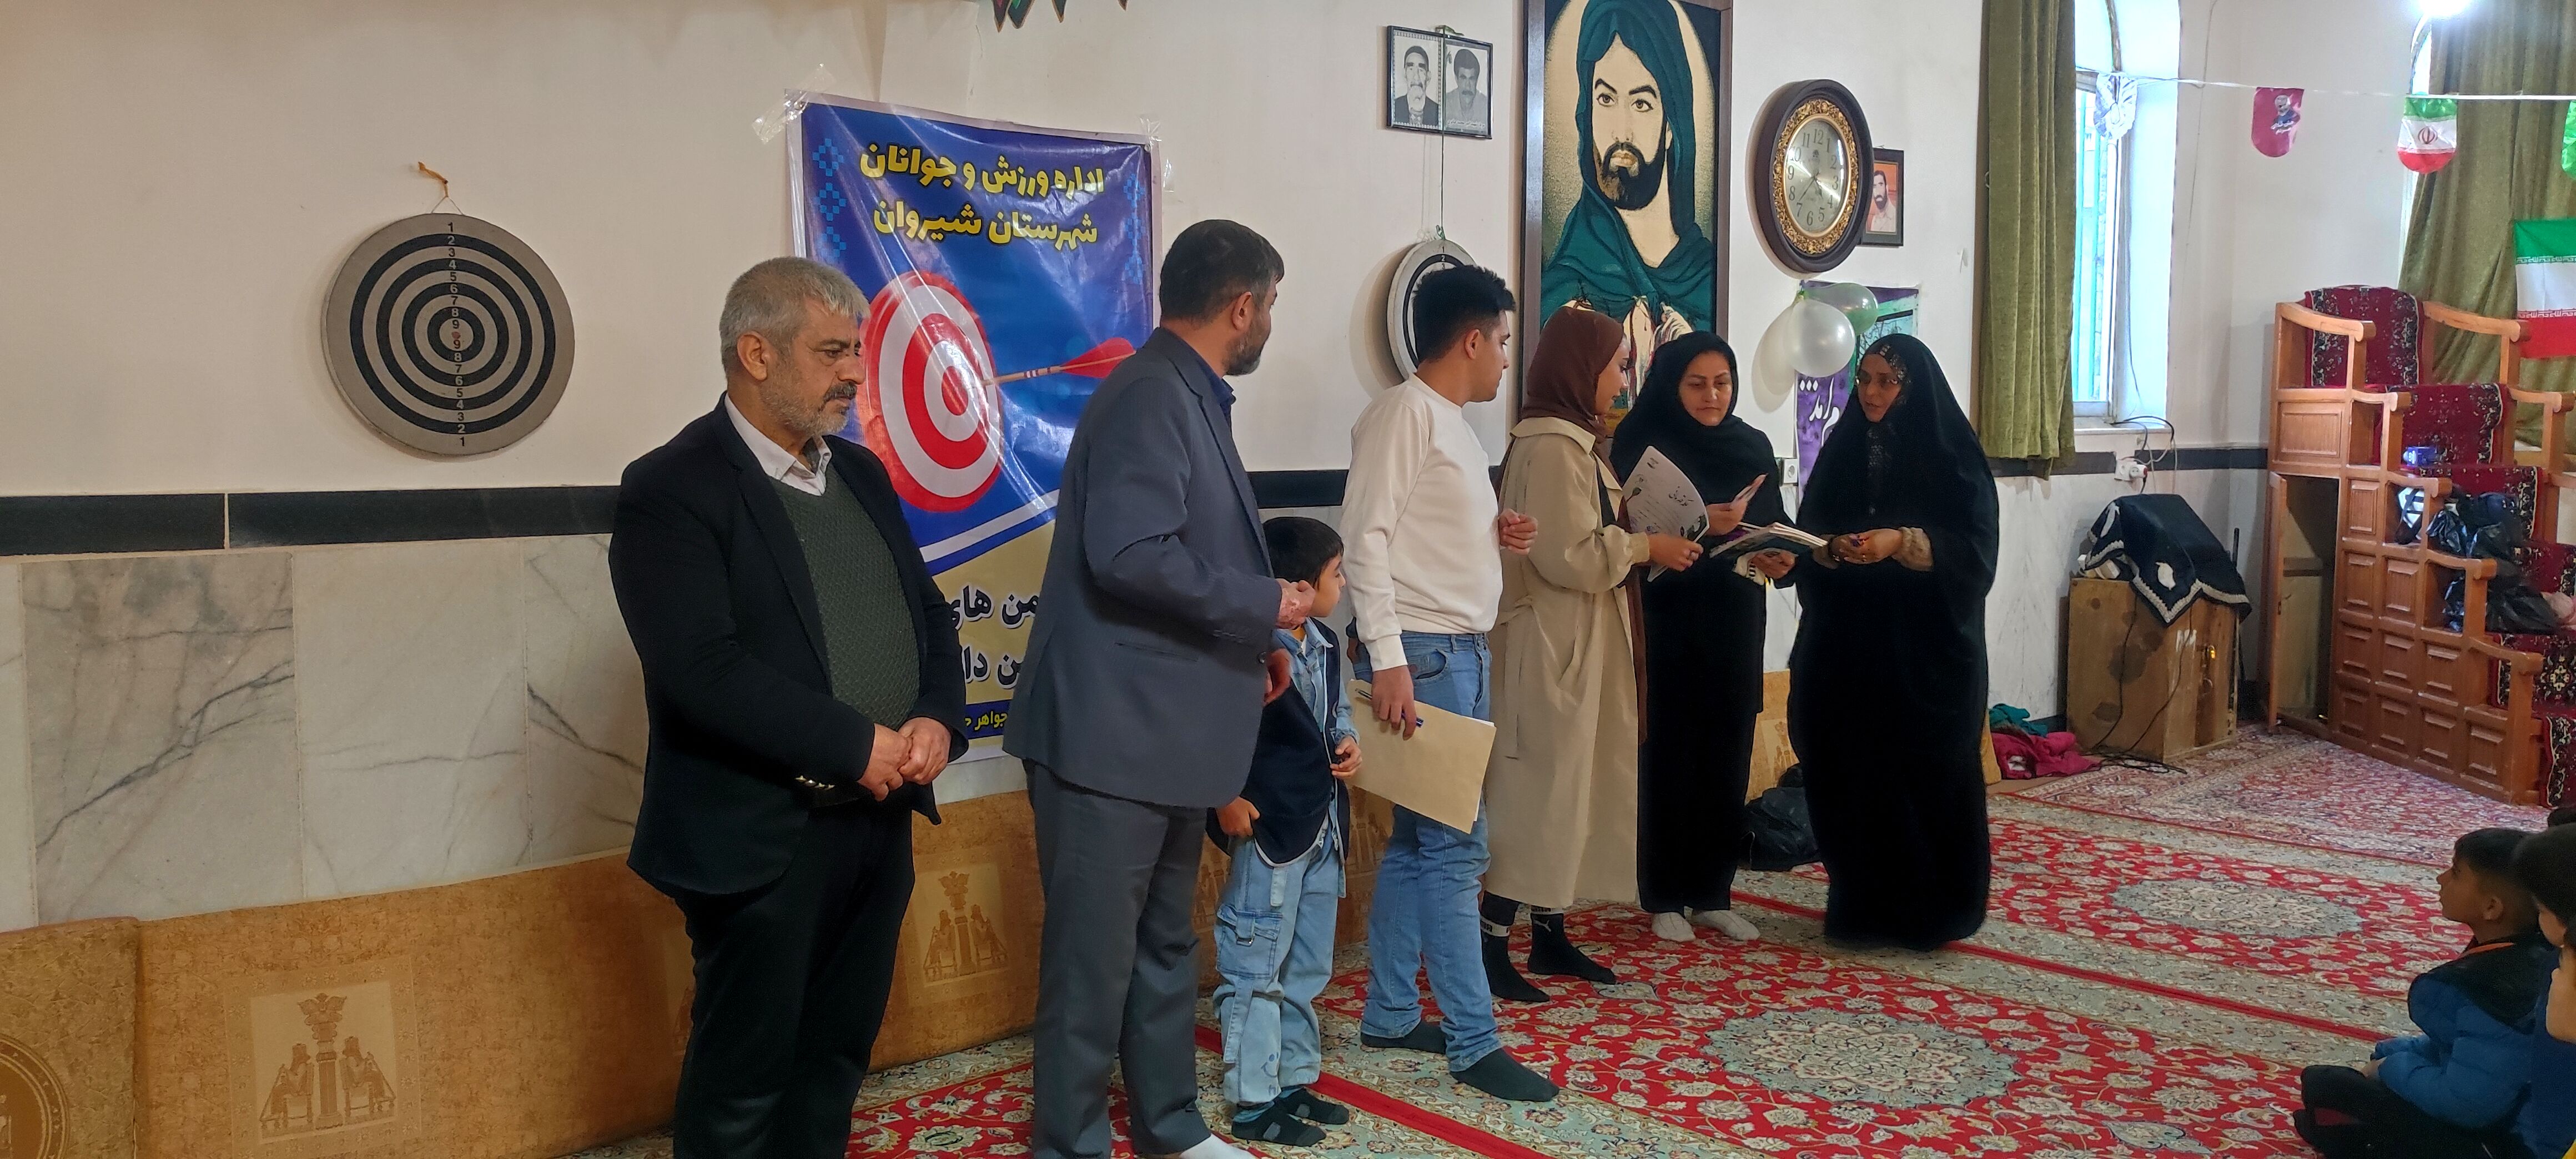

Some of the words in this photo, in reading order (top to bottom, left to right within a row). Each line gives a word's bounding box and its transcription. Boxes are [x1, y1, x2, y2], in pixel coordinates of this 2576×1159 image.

[1802, 133, 1810, 148] 11
[1813, 128, 1824, 145] 12
[1826, 138, 1831, 153] 1
[861, 144, 957, 187] جوانان
[1830, 155, 1837, 170] 2
[963, 163, 975, 191] و
[982, 155, 1049, 198] ورزش
[1788, 165, 1794, 180] 9
[1054, 166, 1104, 200] اداره
[1832, 175, 1839, 190] 3
[1789, 185, 1795, 201] 8
[1827, 194, 1833, 209] 4
[1796, 202, 1803, 218] 7
[1818, 207, 1825, 222] 5
[874, 200, 982, 240] شیروان
[1807, 211, 1813, 226] 6
[448, 222, 453, 232] 1
[989, 211, 1097, 250] شهرستان
[447, 235, 455, 245] 2
[449, 248, 455, 257] 3
[449, 260, 456, 269] 4
[450, 272, 456, 281] 5
[450, 284, 458, 294] 6
[451, 296, 458, 305] 7
[451, 308, 459, 317] 8
[452, 320, 459, 329] 9
[454, 339, 461, 349] 9
[454, 352, 461, 361] 8
[455, 364, 462, 373] 7
[455, 376, 462, 385] 6
[456, 388, 463, 397] 5
[456, 400, 464, 410] 4
[457, 412, 464, 421] 3
[457, 424, 466, 434] 2
[460, 436, 465, 447] 1
